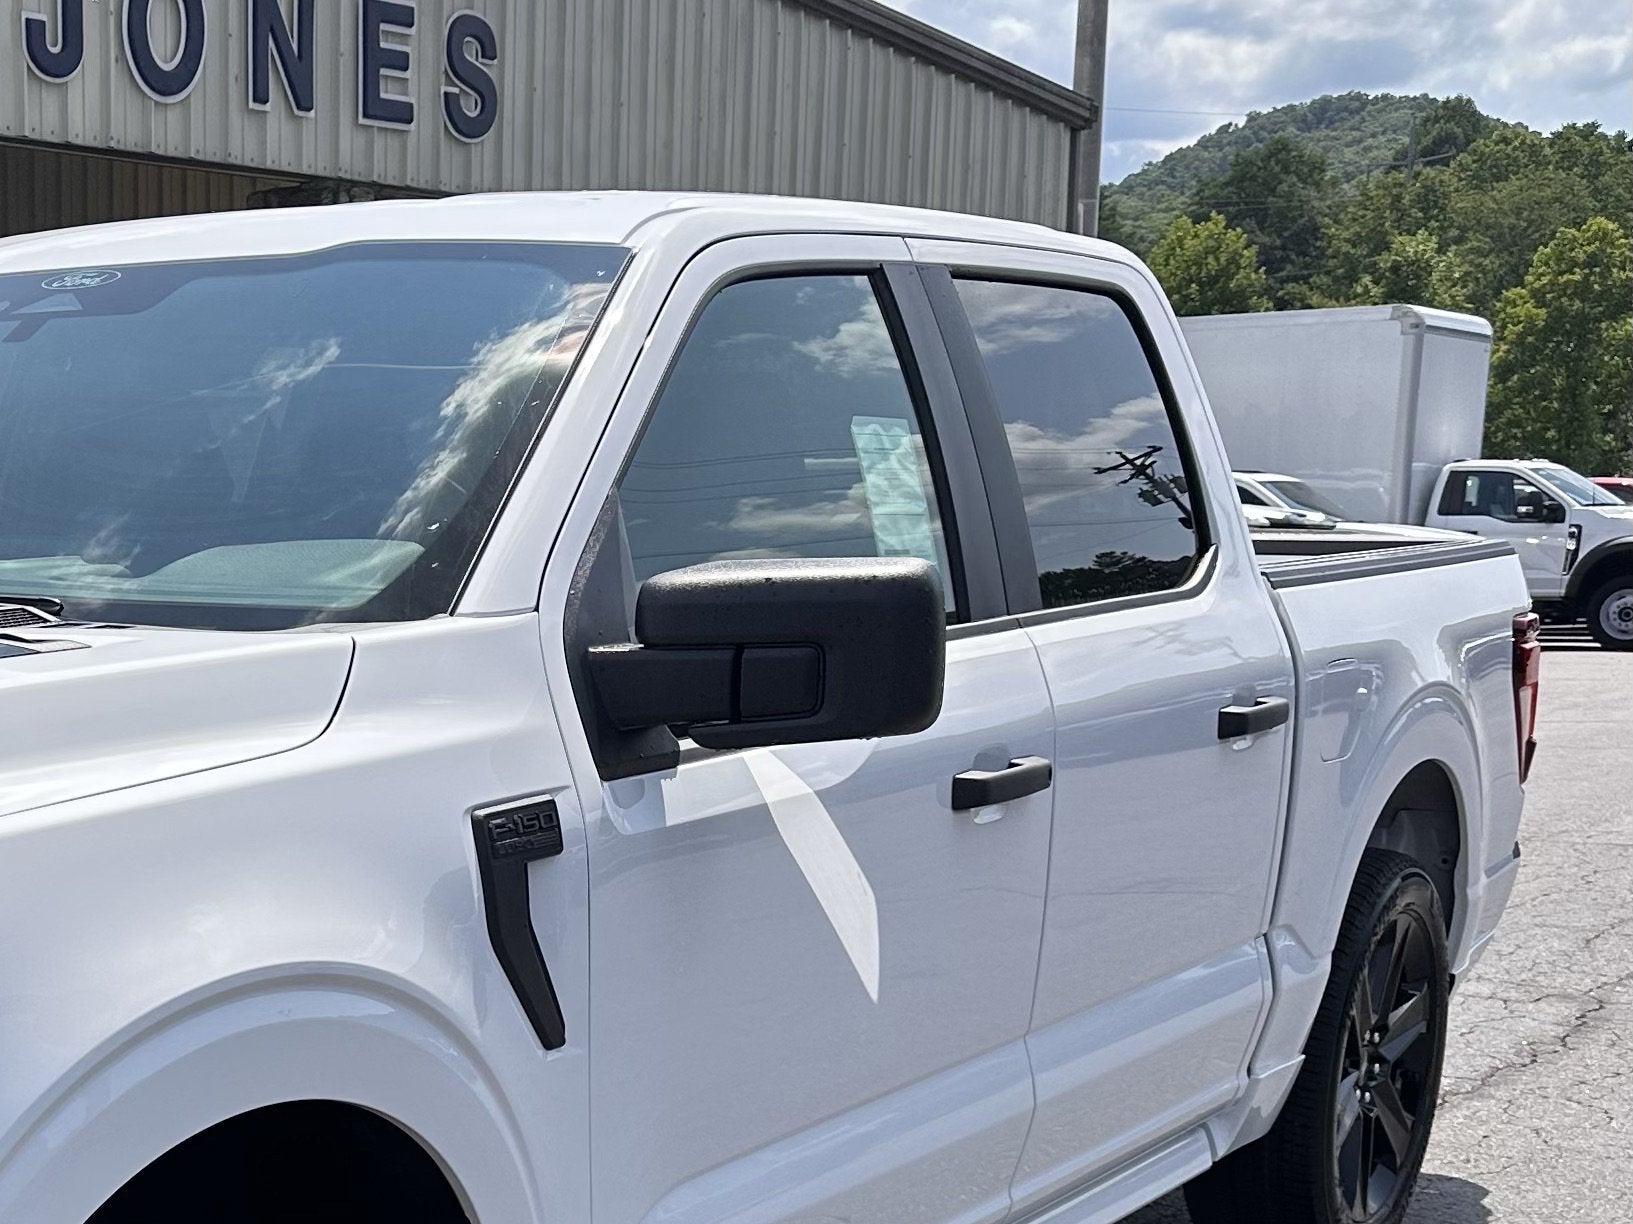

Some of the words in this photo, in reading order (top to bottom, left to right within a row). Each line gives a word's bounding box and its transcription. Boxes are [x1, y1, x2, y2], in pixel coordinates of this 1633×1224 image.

[22, 0, 498, 143] JONES
[52, 271, 110, 288] Ford
[489, 811, 558, 841] F-150
